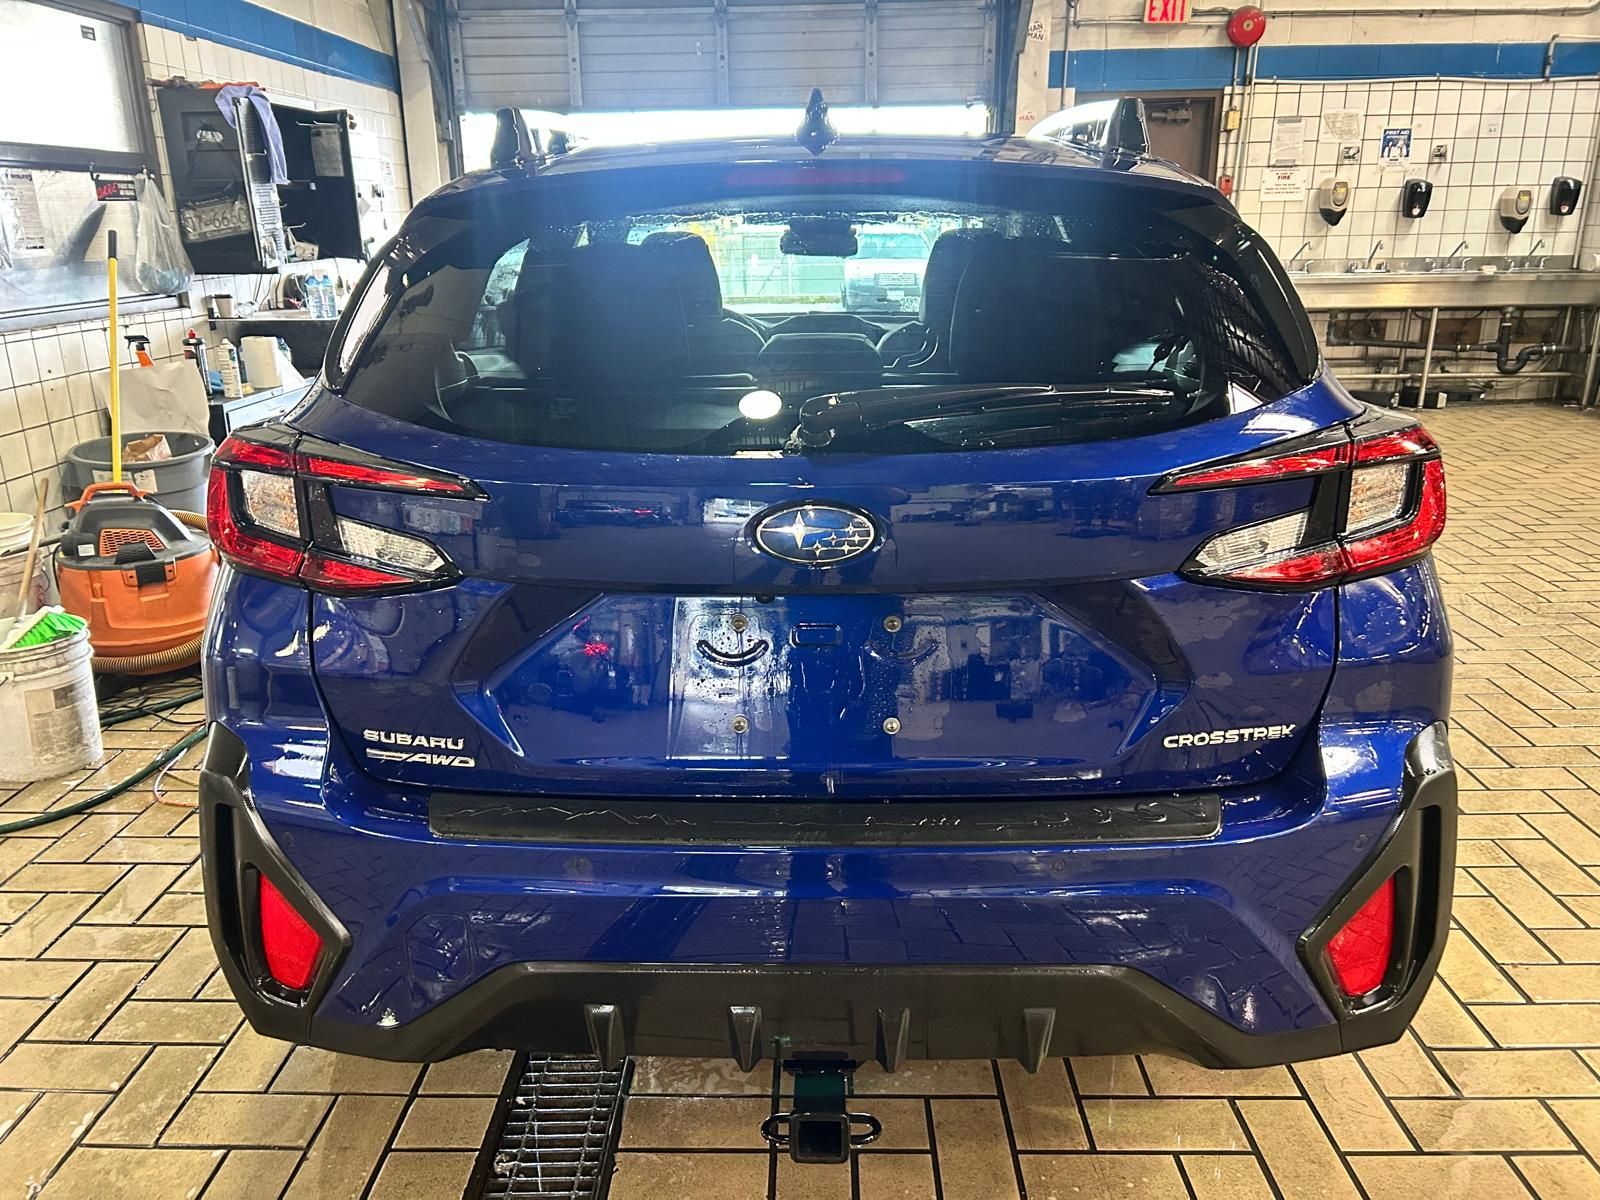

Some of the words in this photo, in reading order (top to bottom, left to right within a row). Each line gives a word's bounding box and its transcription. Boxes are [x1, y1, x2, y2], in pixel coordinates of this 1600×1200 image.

[1147, 0, 1186, 22] EXIT
[363, 729, 465, 750] SUBARU
[1163, 724, 1296, 749] CROSSTREK
[406, 752, 476, 768] AWD
